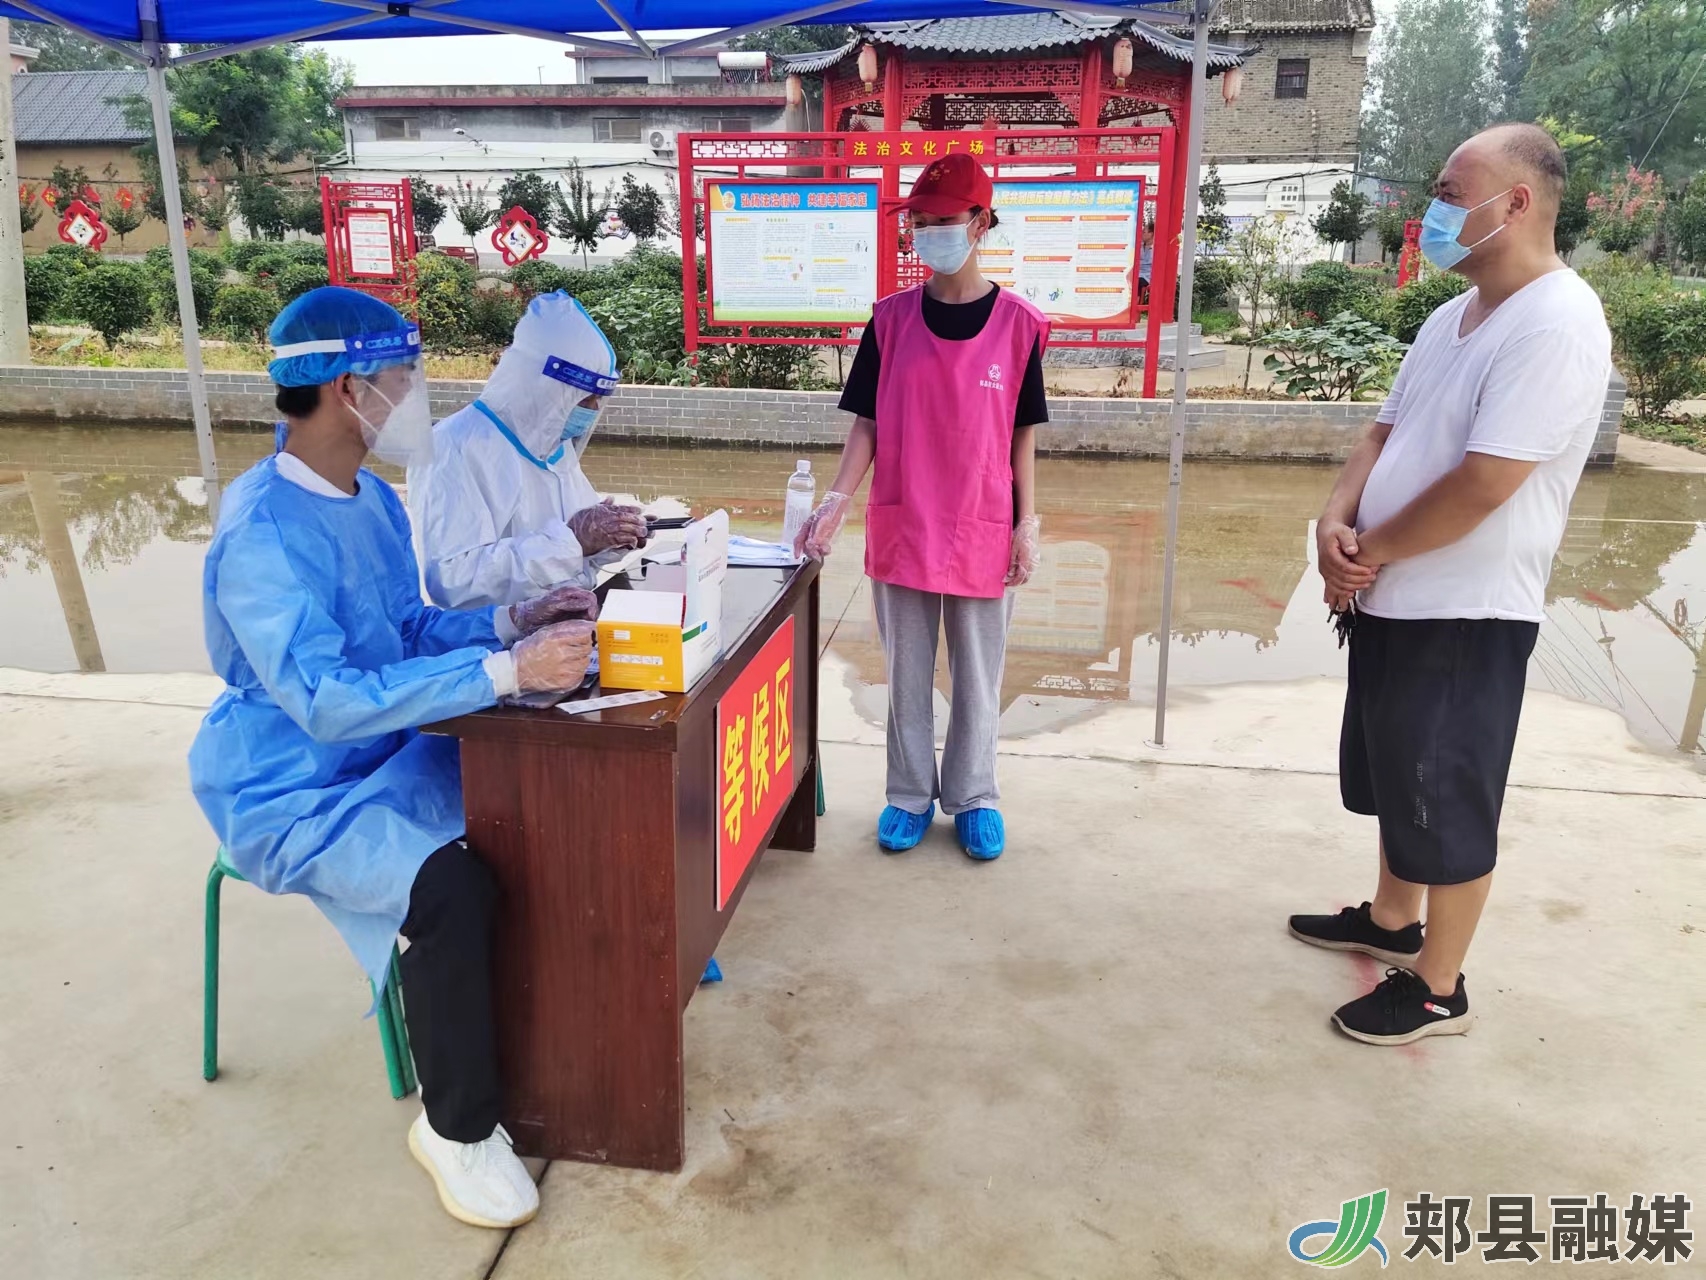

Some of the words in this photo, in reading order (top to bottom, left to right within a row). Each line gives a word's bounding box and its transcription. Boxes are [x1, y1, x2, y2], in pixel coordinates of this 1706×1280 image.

[853, 139, 984, 156] 法治文化广场
[740, 192, 800, 208] 弘扬法治精神
[808, 192, 868, 208] 共建幸福家庭
[723, 656, 791, 846] 等候区
